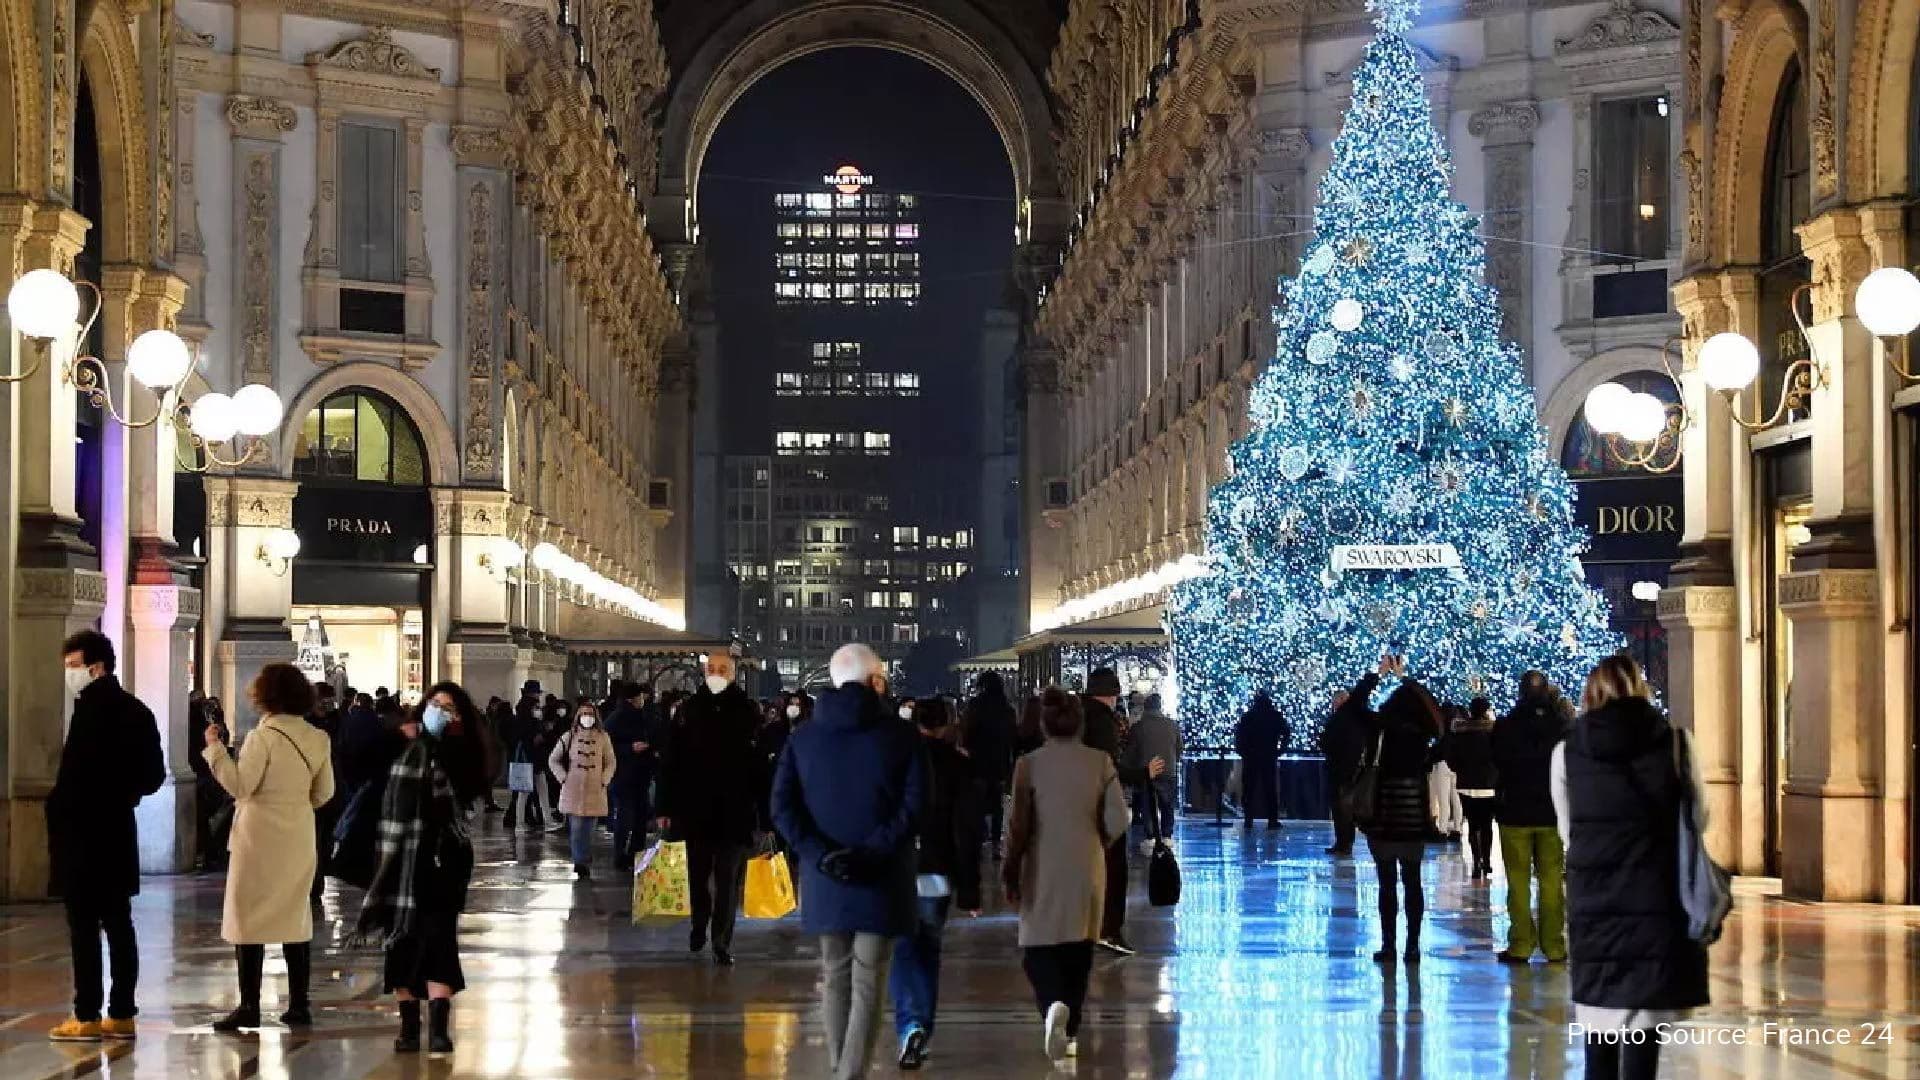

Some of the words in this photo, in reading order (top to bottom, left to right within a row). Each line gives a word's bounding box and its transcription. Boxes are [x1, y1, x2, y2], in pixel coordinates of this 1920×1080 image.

[824, 175, 873, 185] MARTINI
[327, 518, 391, 534] PRADA
[1596, 505, 1677, 534] DIOR
[1346, 548, 1442, 565] SWAROVSKI
